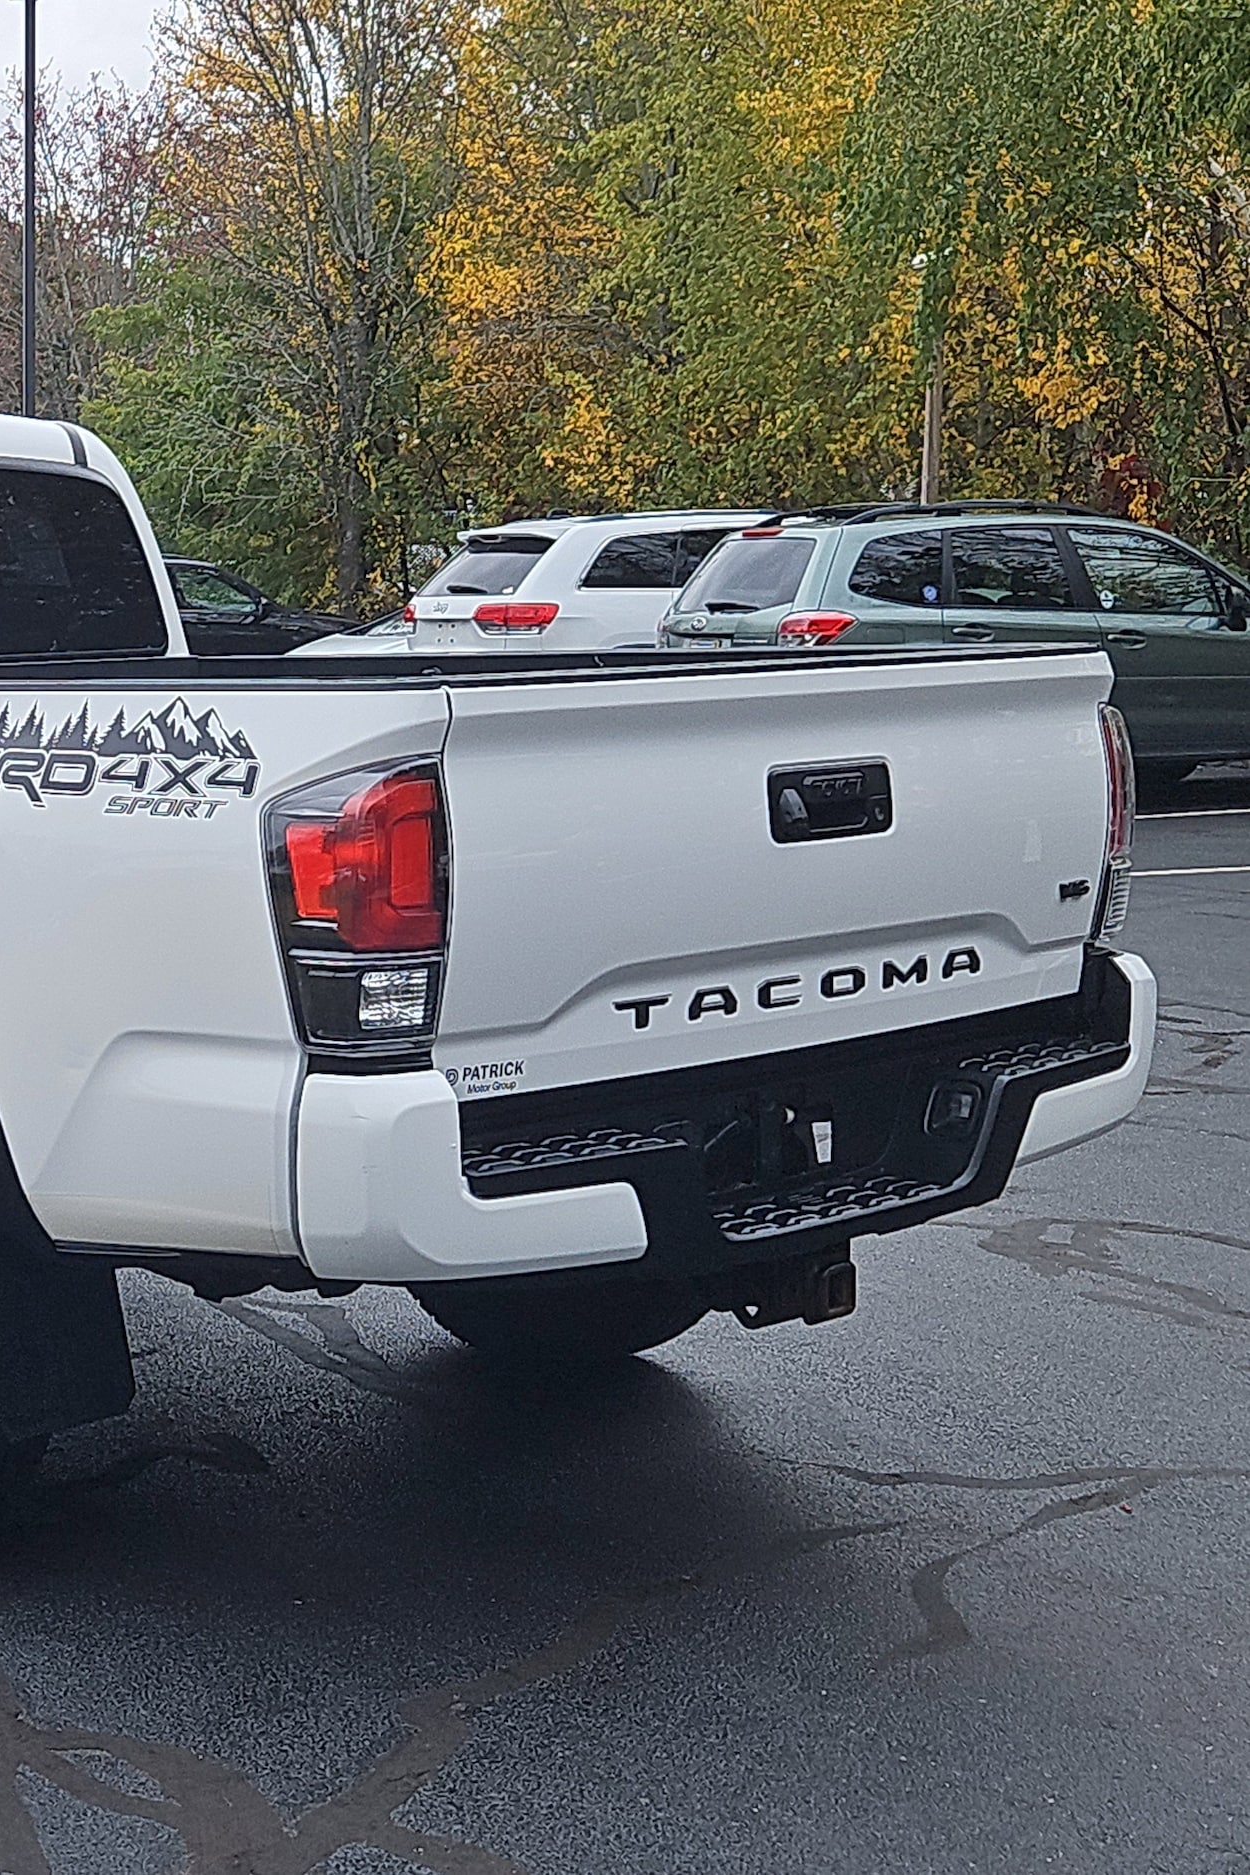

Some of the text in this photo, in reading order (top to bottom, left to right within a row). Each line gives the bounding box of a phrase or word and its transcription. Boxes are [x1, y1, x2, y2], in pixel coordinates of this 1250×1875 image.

[103, 795, 229, 820] SPORT
[611, 945, 983, 1031] TACOMA
[461, 1059, 525, 1082] PATRICK
[467, 1081, 517, 1094] Motor Group
